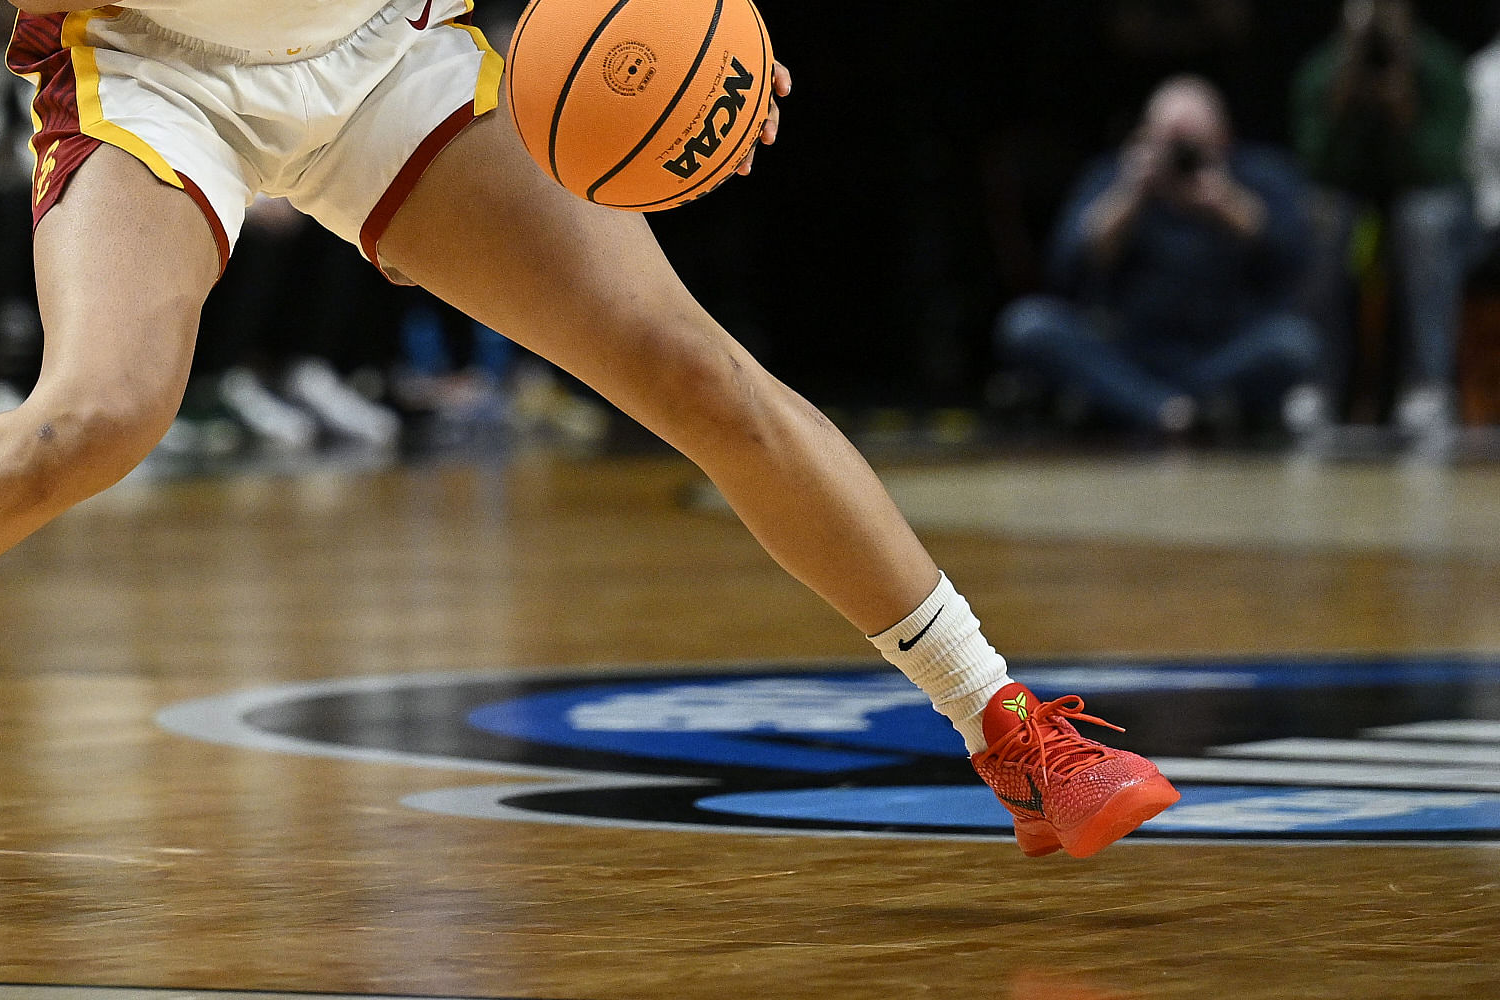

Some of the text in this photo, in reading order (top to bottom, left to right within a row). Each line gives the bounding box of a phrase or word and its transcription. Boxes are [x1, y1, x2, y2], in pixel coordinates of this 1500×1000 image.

[655, 50, 729, 161] OFFICIAL GAME BALL
[662, 55, 754, 179] NCAA
